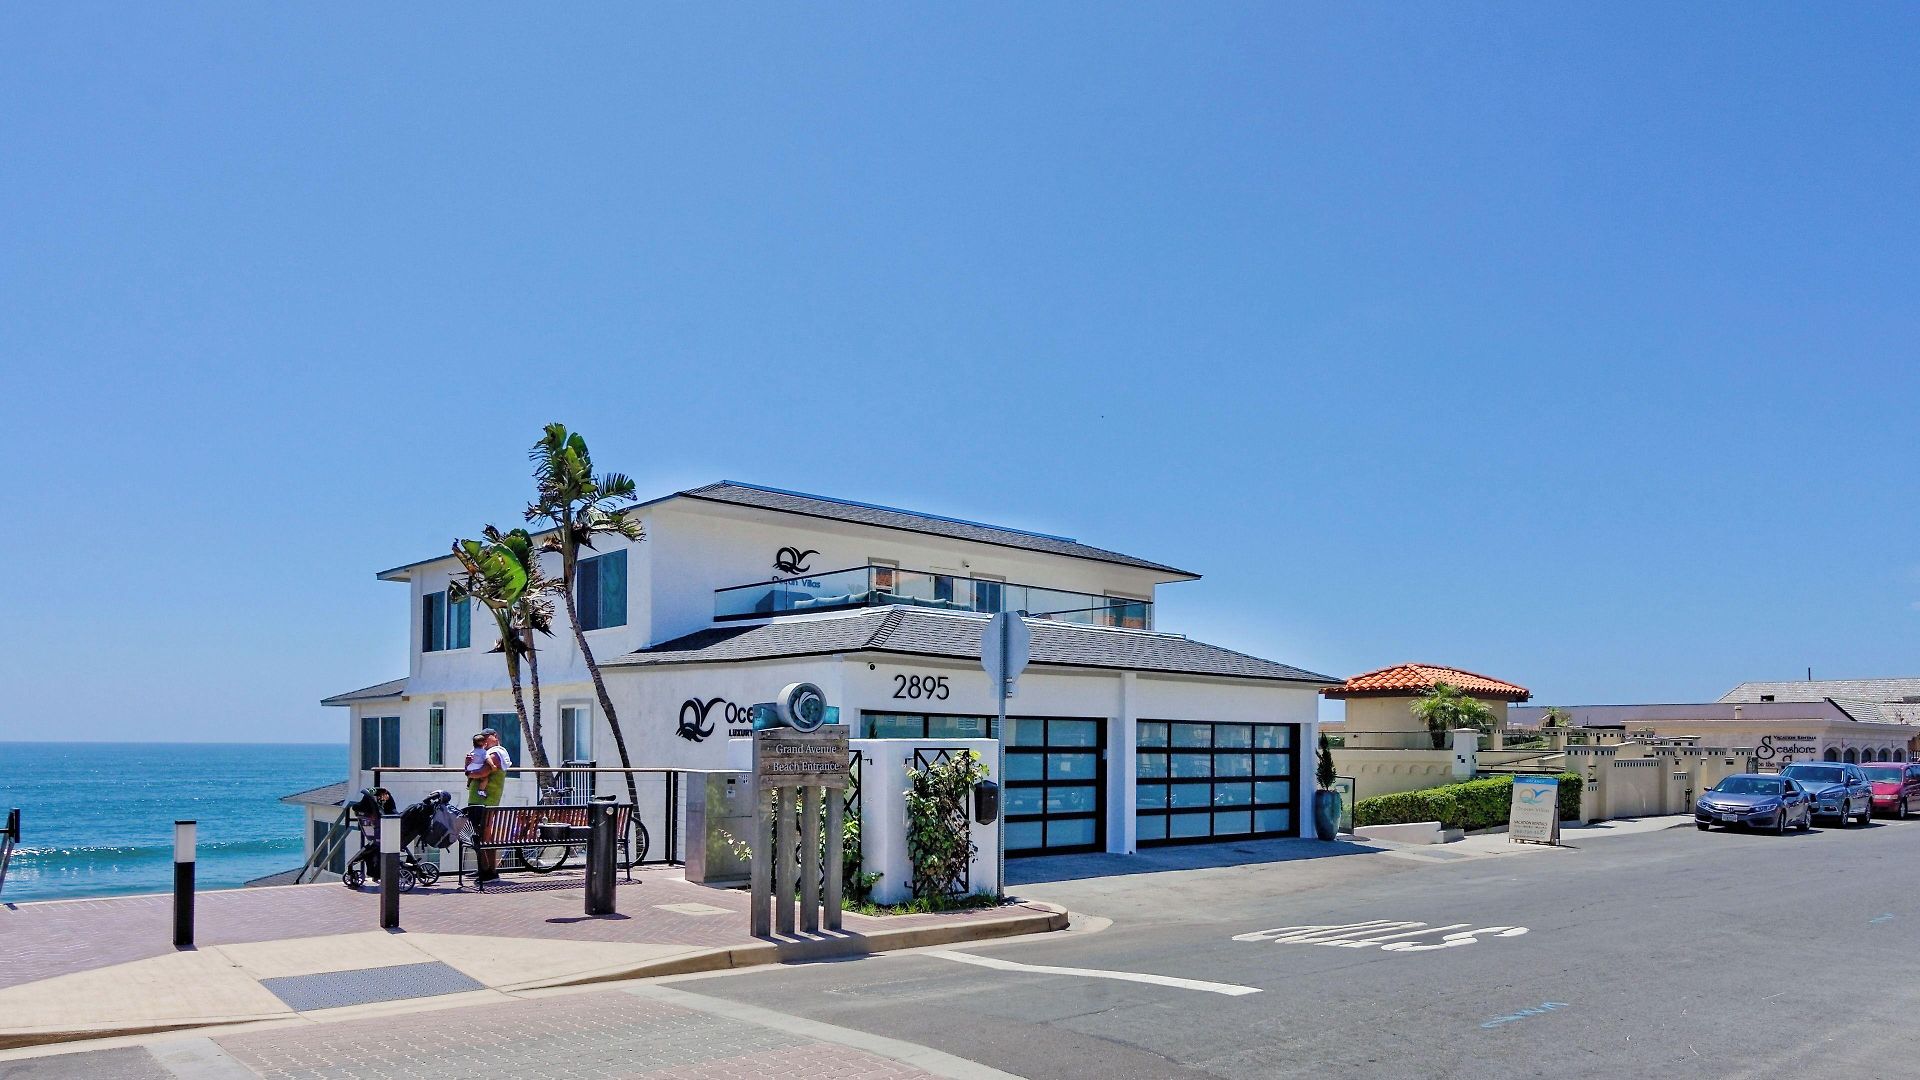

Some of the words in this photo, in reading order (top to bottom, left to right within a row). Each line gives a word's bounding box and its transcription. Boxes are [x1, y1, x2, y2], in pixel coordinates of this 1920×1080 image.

[892, 674, 950, 700] 2895
[728, 728, 753, 737] LUXURY
[775, 743, 804, 754] Grand
[805, 743, 837, 754] Avenue
[1756, 735, 1816, 760] Seashore
[773, 761, 800, 772] Beach
[802, 761, 840, 771] Entrance
[1765, 760, 1775, 768] the
